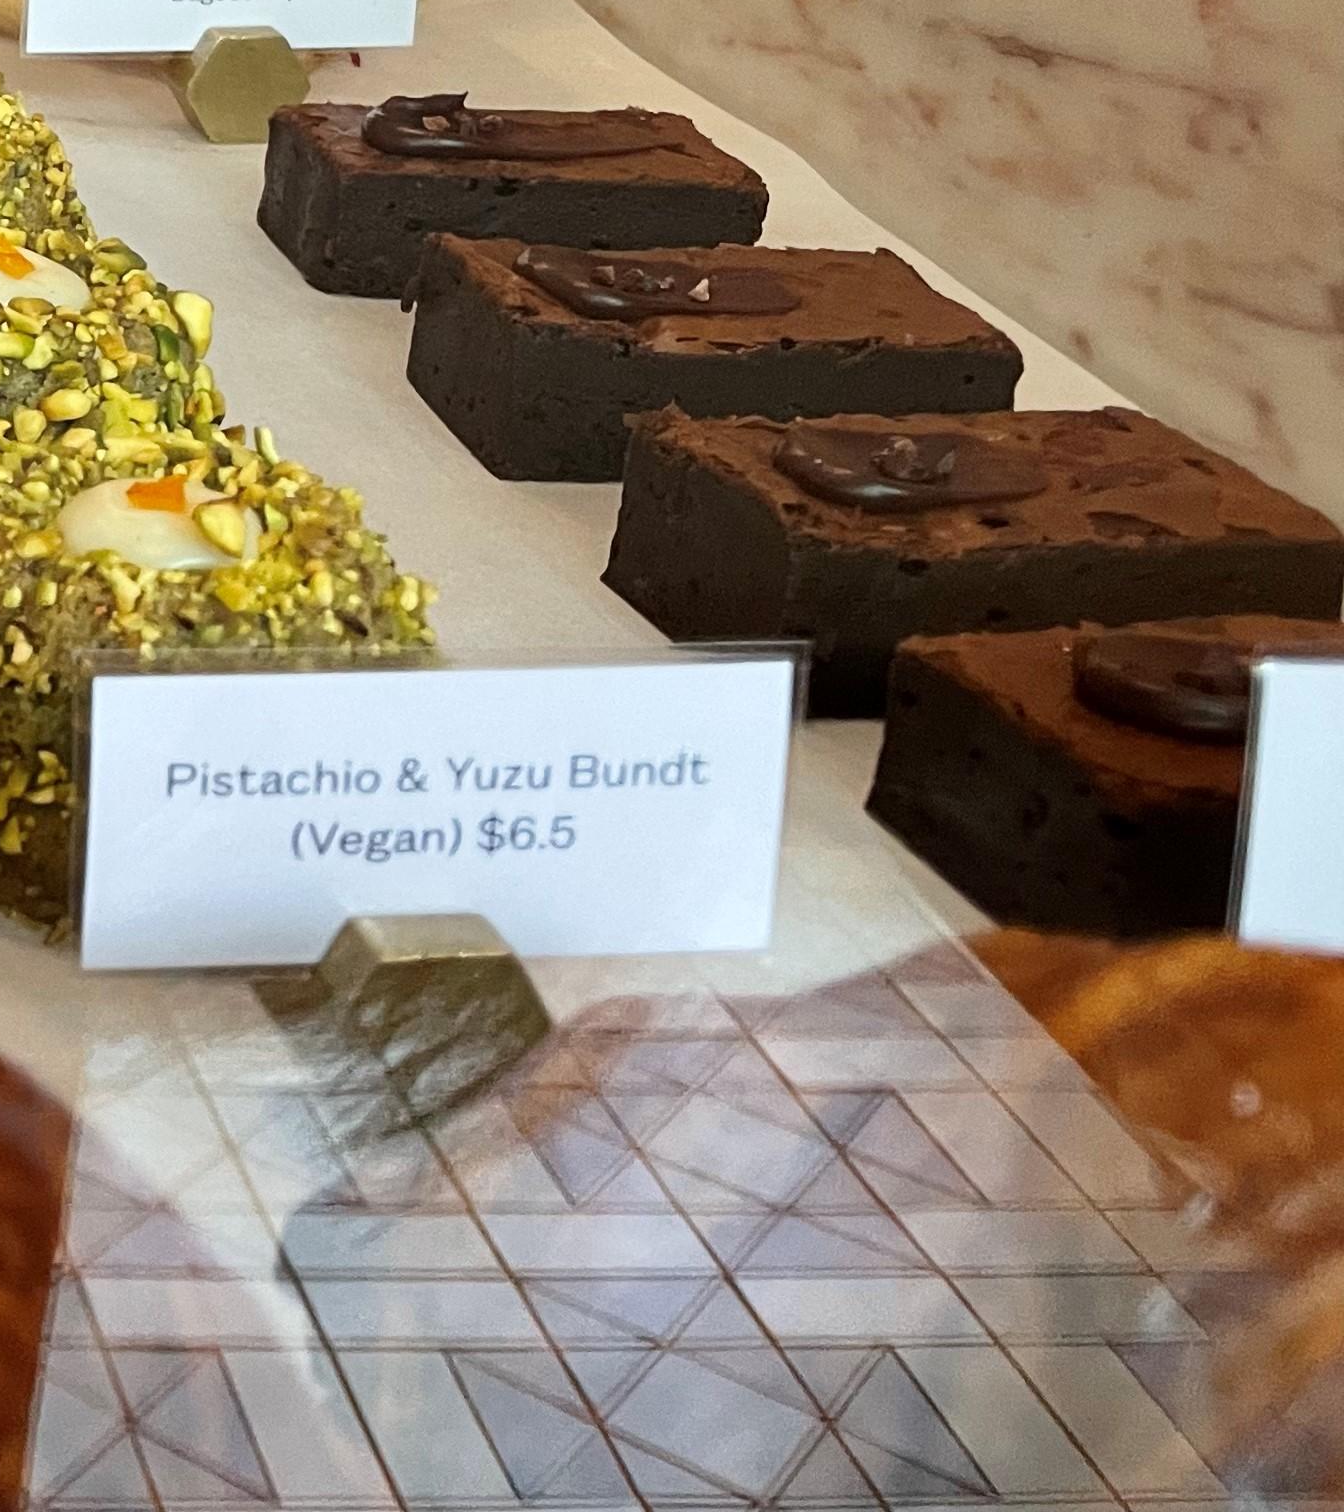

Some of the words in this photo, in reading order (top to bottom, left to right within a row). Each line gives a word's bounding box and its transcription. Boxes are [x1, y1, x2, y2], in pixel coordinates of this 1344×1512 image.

[165, 758, 381, 798] Pistachio
[396, 757, 429, 793] &
[445, 756, 552, 791] Yuzu
[568, 750, 710, 788] Bundt
[290, 817, 463, 863] (Vegan)
[476, 812, 577, 854] $6.5
